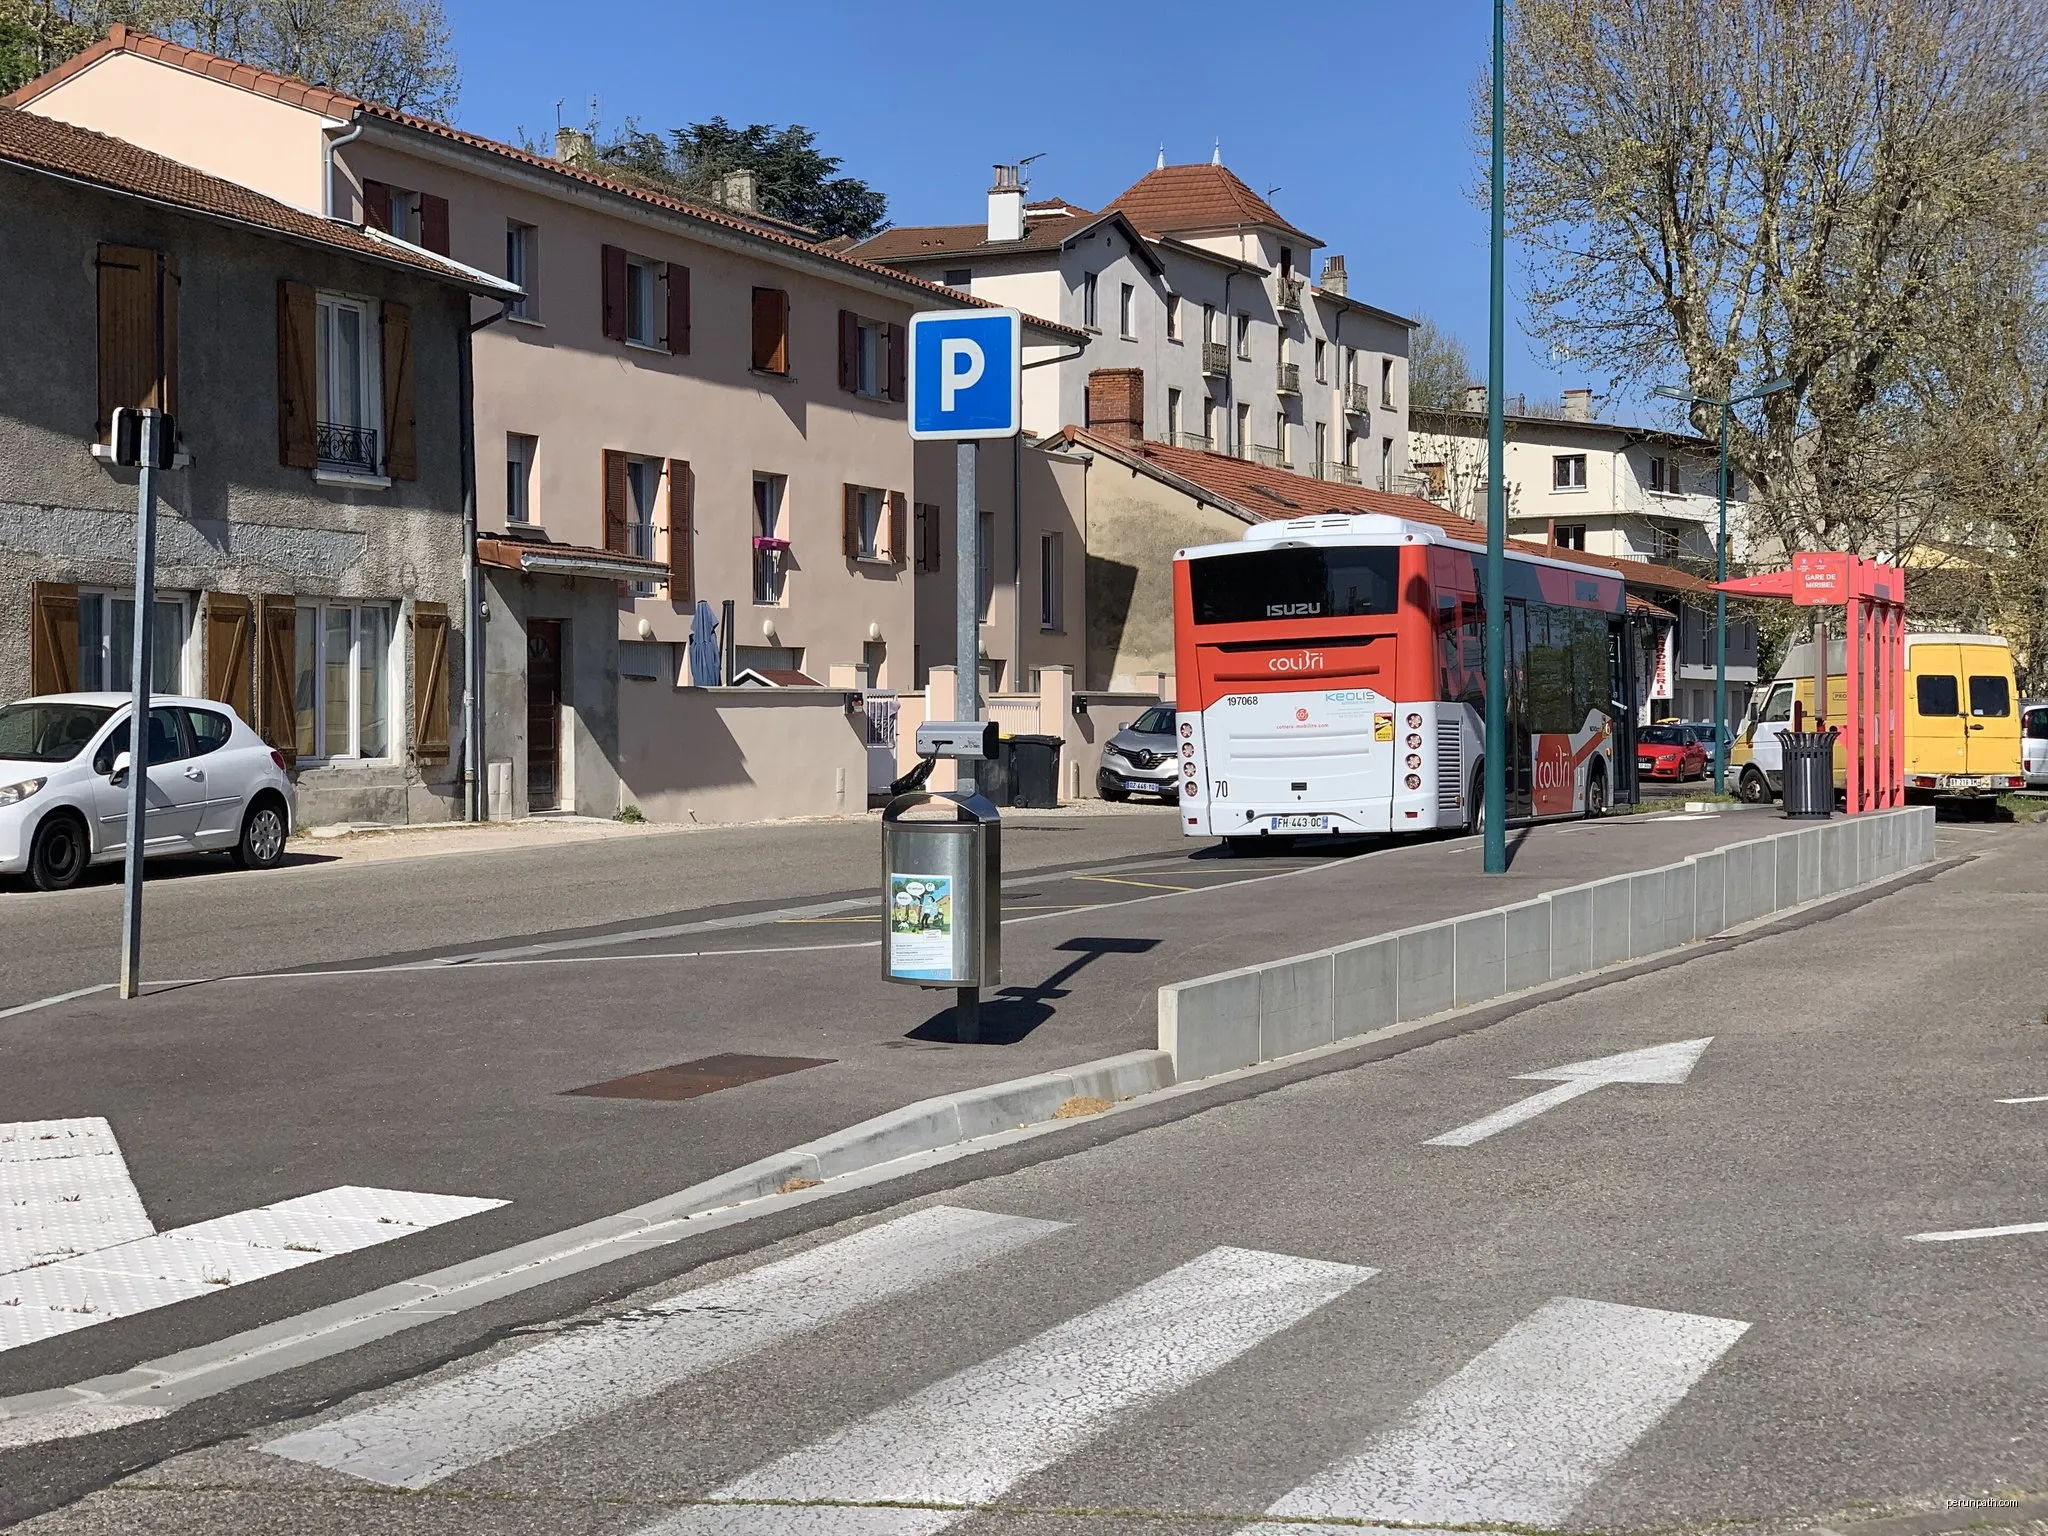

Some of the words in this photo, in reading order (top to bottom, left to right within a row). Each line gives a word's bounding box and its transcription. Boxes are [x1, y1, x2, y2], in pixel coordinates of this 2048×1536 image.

[941, 337, 985, 412] P
[1804, 573, 1825, 581] GARE
[1826, 573, 1837, 581] DE
[1805, 581, 1836, 589] MIRIBEL
[1266, 602, 1321, 617] ISUZU
[1226, 695, 1259, 707] 197068
[1214, 780, 1228, 798] 70
